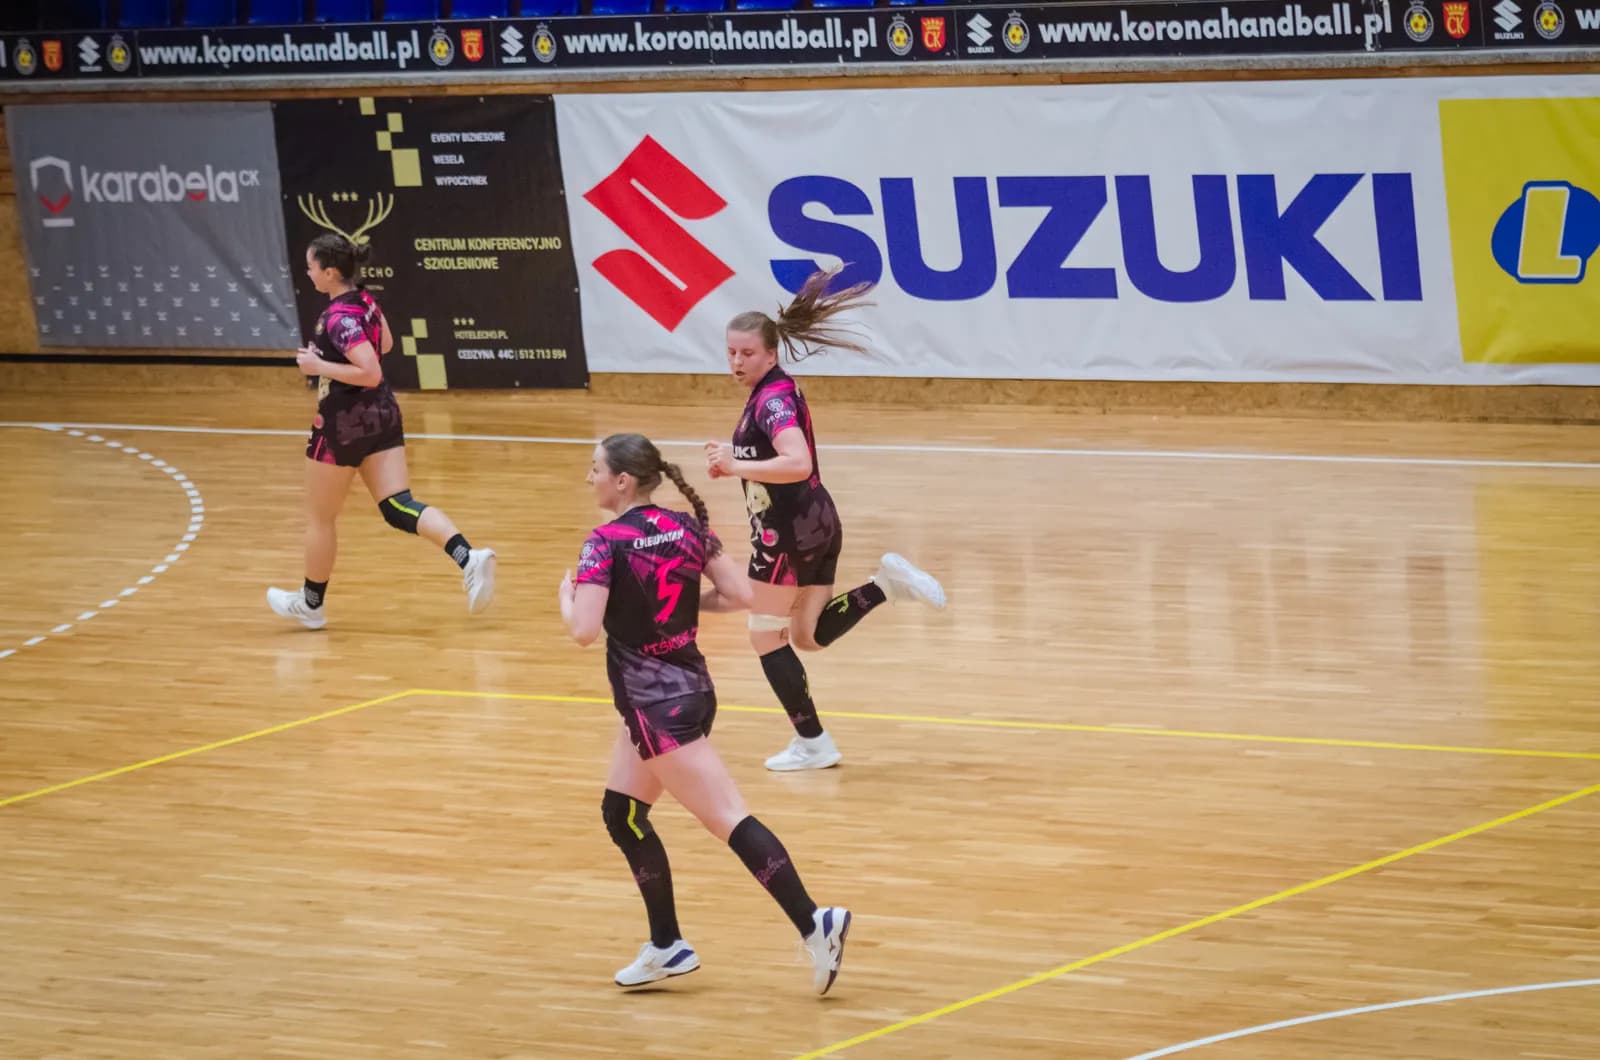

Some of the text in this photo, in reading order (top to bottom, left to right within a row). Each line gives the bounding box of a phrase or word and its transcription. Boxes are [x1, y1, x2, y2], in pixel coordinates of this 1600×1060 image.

[563, 17, 877, 57] www.koronahandball.pl
[1038, 0, 1393, 52] www.koronahandball.pl
[1494, 32, 1525, 40] SUZUKI
[139, 29, 421, 69] www.koronahandball.pl
[79, 164, 240, 203] karabela
[414, 236, 563, 252] CENTRUM KONFERENCYJNO
[767, 172, 1424, 303] SUZUKI
[360, 266, 395, 278] ECHO
[654, 556, 685, 625] 5
